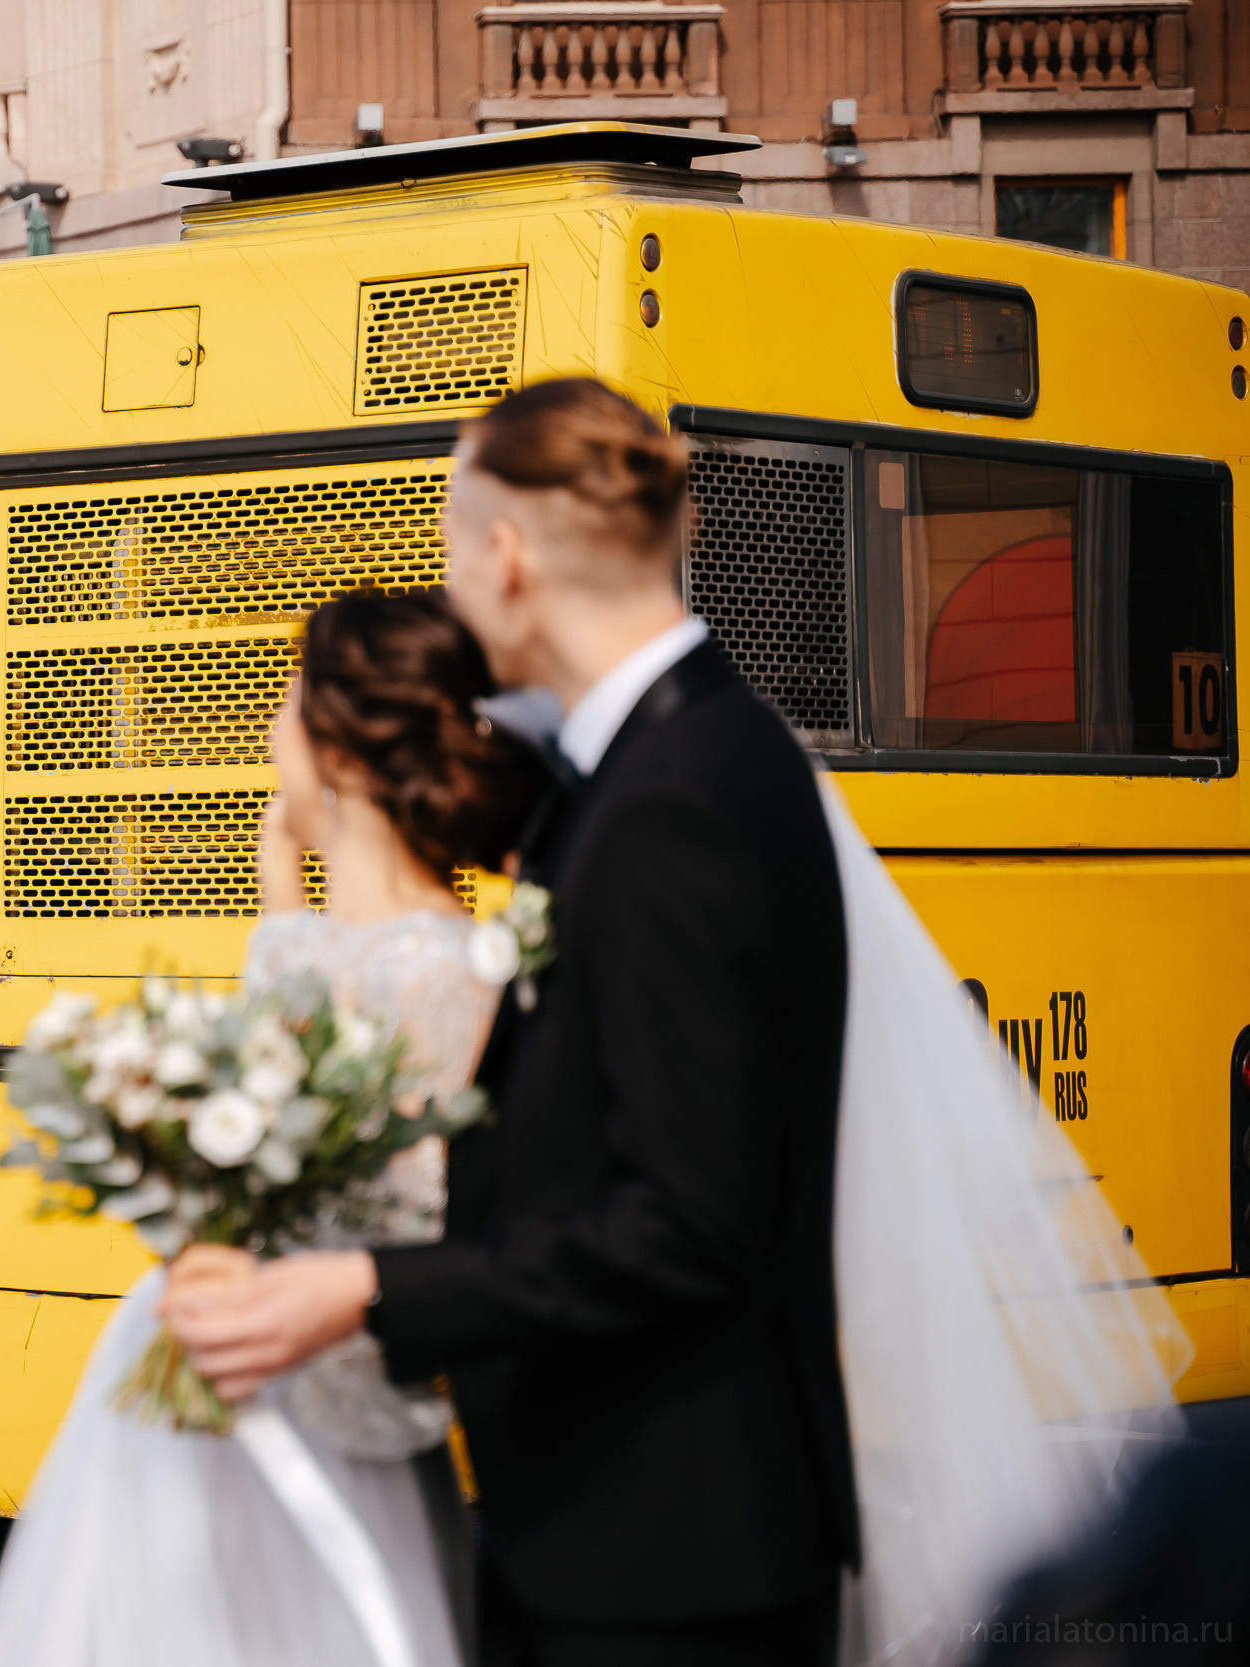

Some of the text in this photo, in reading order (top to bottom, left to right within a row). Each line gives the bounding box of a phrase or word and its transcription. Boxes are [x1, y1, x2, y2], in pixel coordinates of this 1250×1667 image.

[1179, 664, 1221, 736] 10
[1049, 990, 1087, 1061] 178
[1054, 1070, 1088, 1122] RUS
